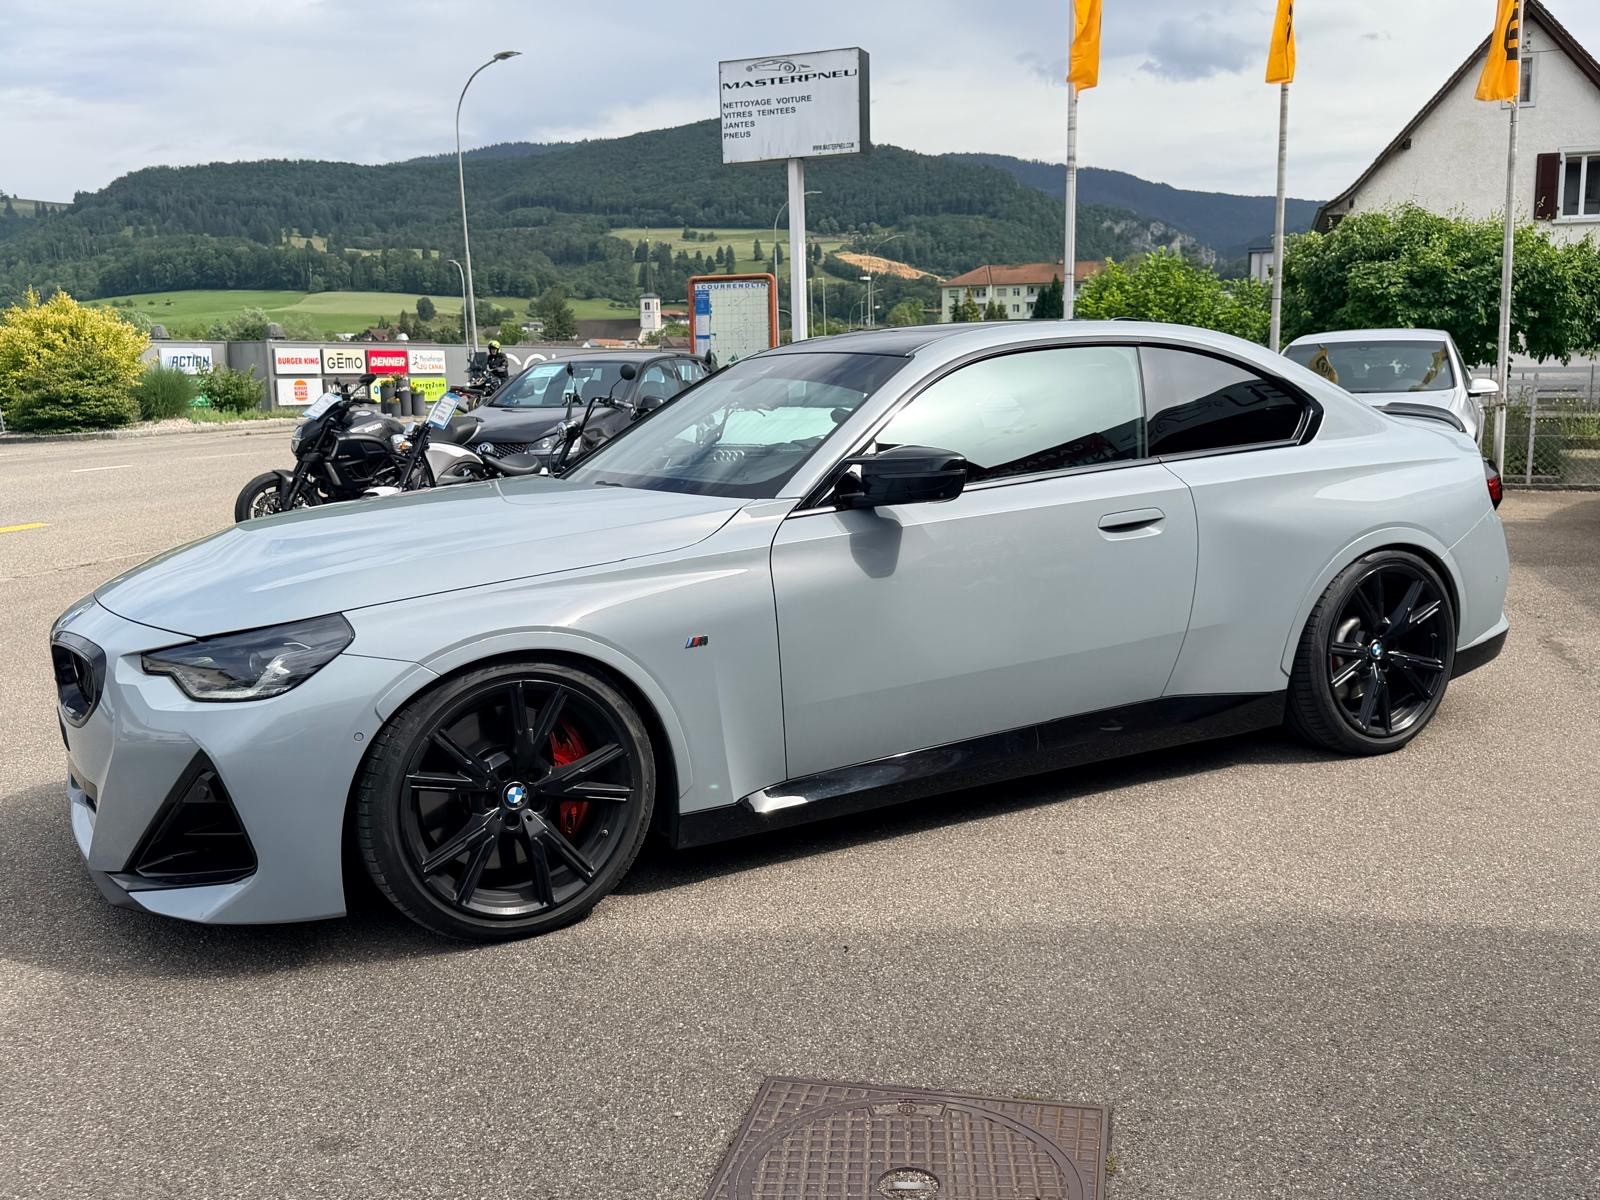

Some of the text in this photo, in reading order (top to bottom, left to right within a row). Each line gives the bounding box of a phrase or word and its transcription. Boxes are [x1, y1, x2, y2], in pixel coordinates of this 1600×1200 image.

[722, 69, 857, 90] MASTERPNEU
[723, 95, 812, 110] NETTOYAGE VOITURE
[723, 106, 796, 120] VITRES TEINTEES
[723, 120, 756, 130] JANTES
[723, 131, 751, 140] PNEUS
[171, 356, 209, 368] ACTION
[277, 357, 319, 365] BURGER KING
[371, 357, 405, 367] DENNER
